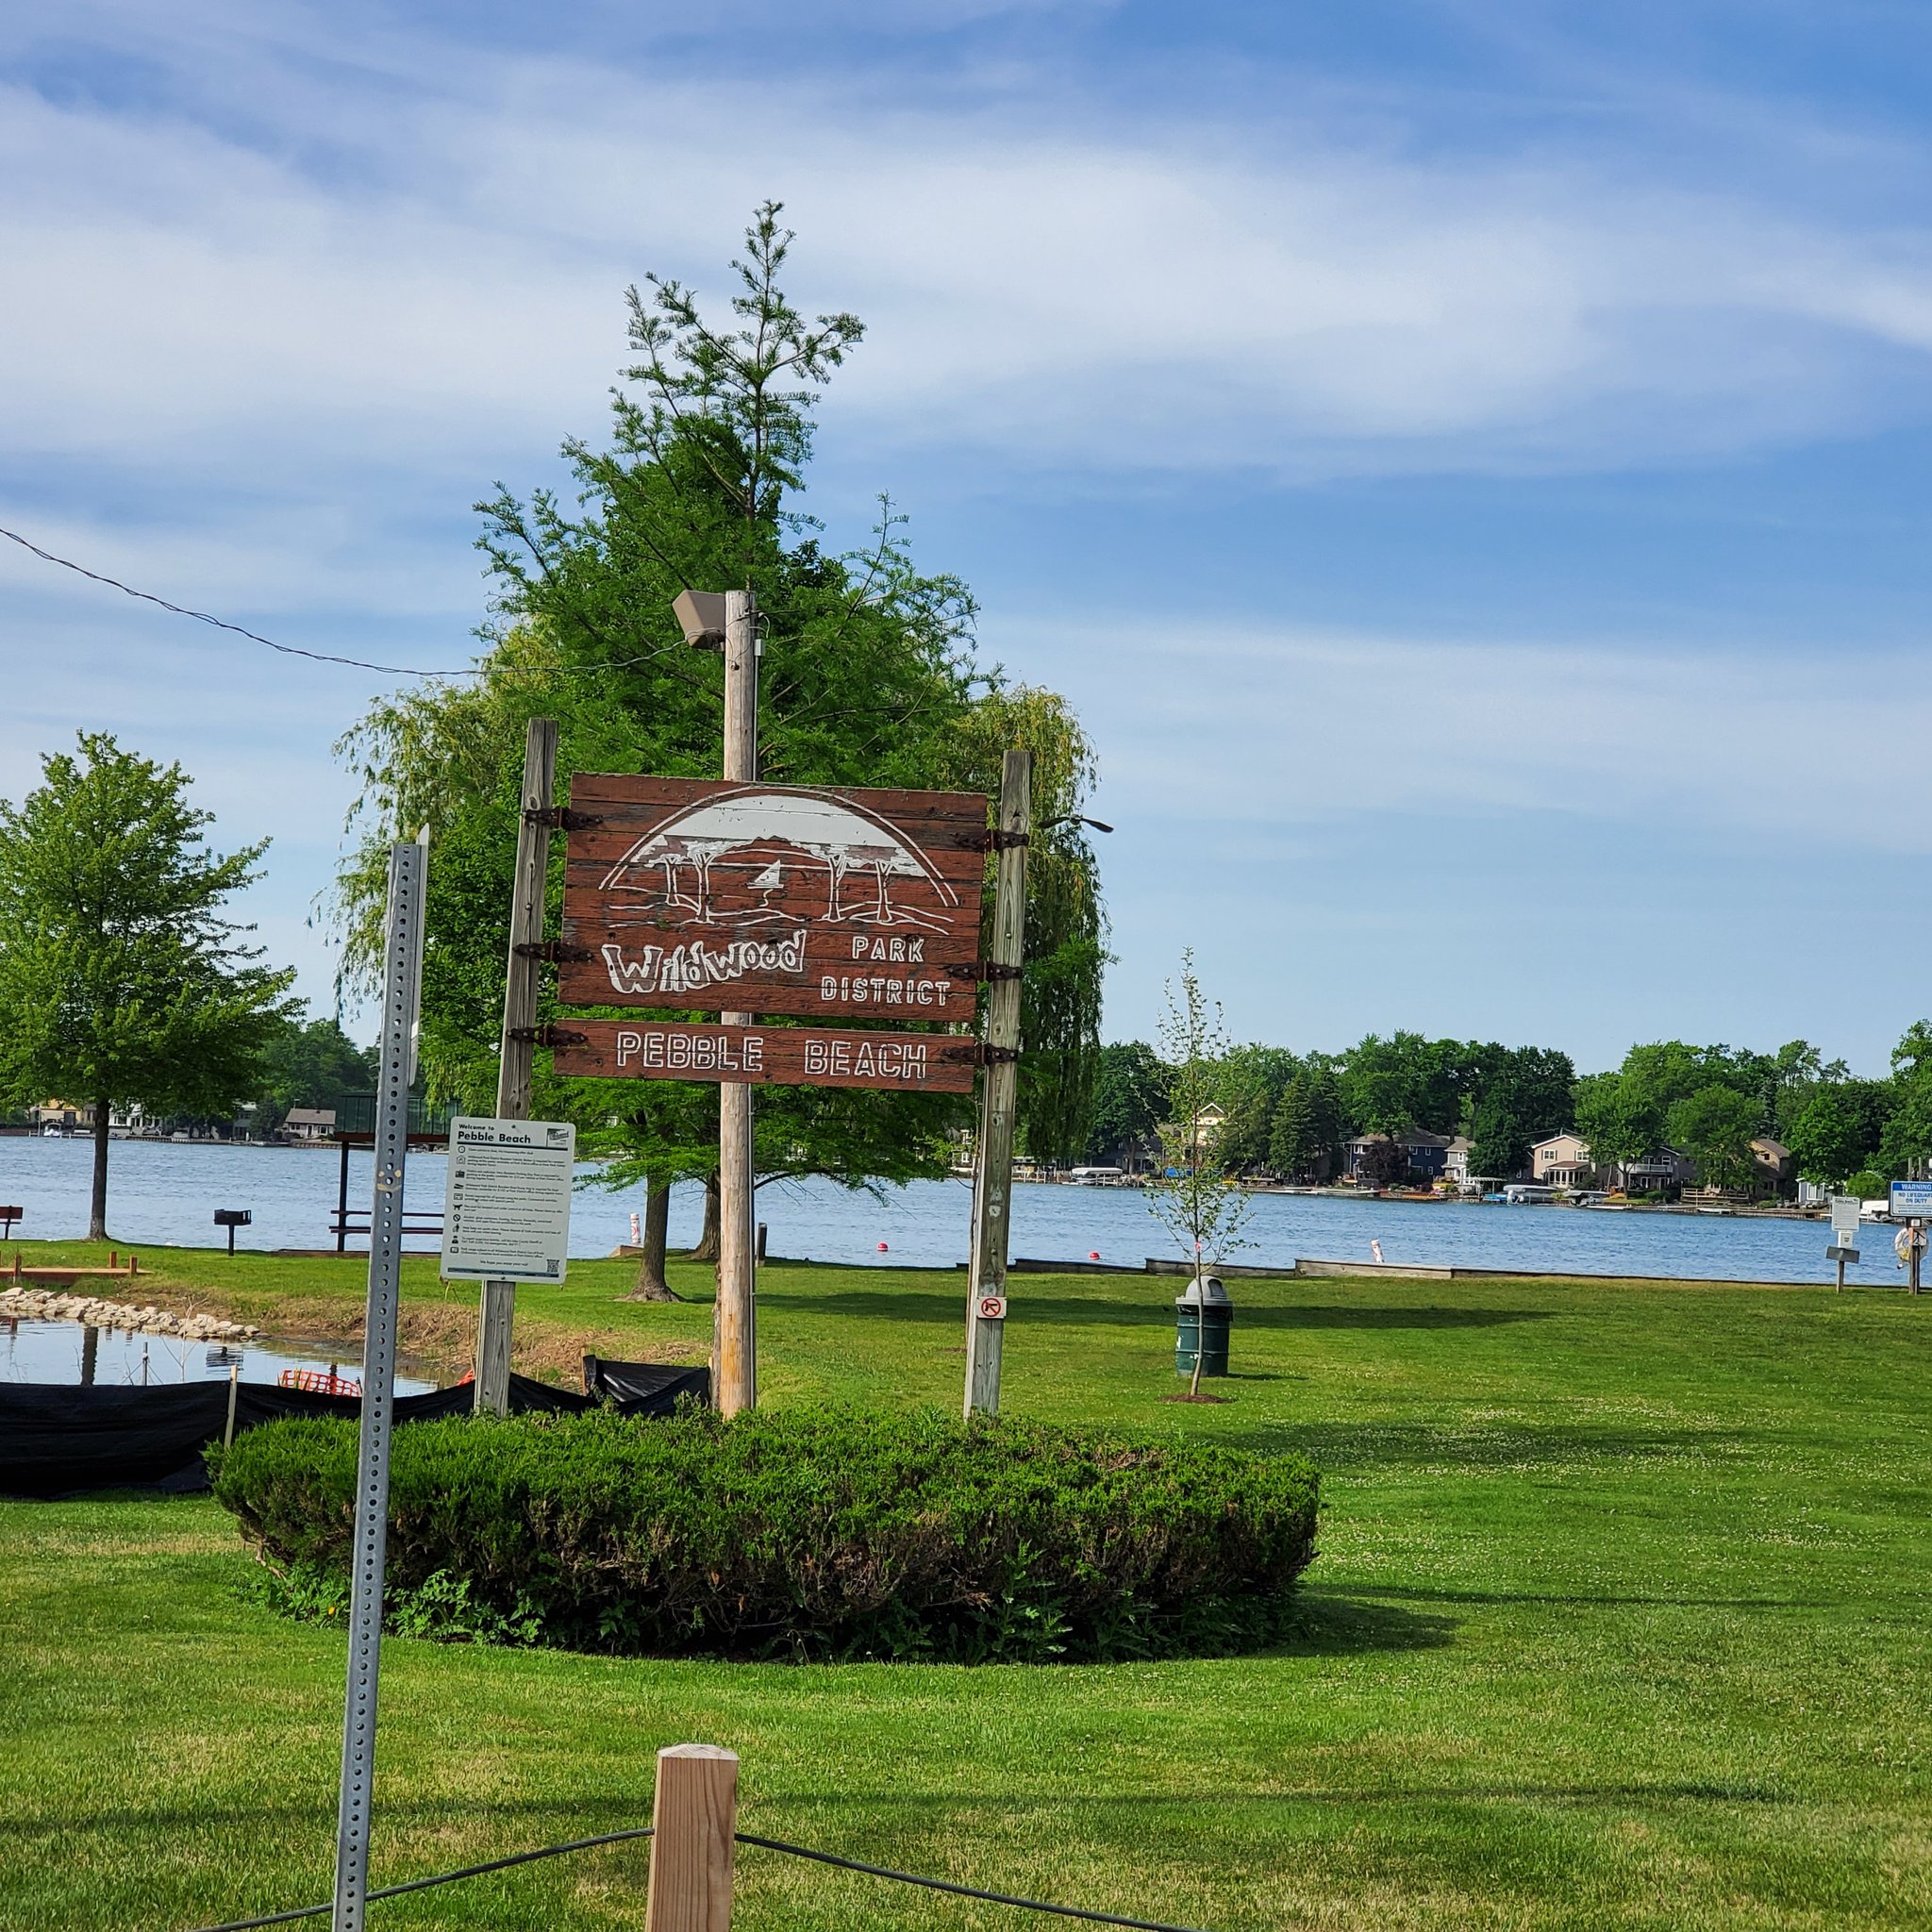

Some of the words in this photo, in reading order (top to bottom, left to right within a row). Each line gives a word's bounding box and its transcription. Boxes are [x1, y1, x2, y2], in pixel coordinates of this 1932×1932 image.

[602, 929, 807, 993] Wildwood
[852, 936, 924, 962] PARK
[821, 975, 951, 1006] DISTRICT
[616, 1031, 763, 1072] PEBBLE
[804, 1040, 926, 1078] BEACH
[458, 1131, 494, 1142] Pebble
[498, 1133, 531, 1144] Beach
